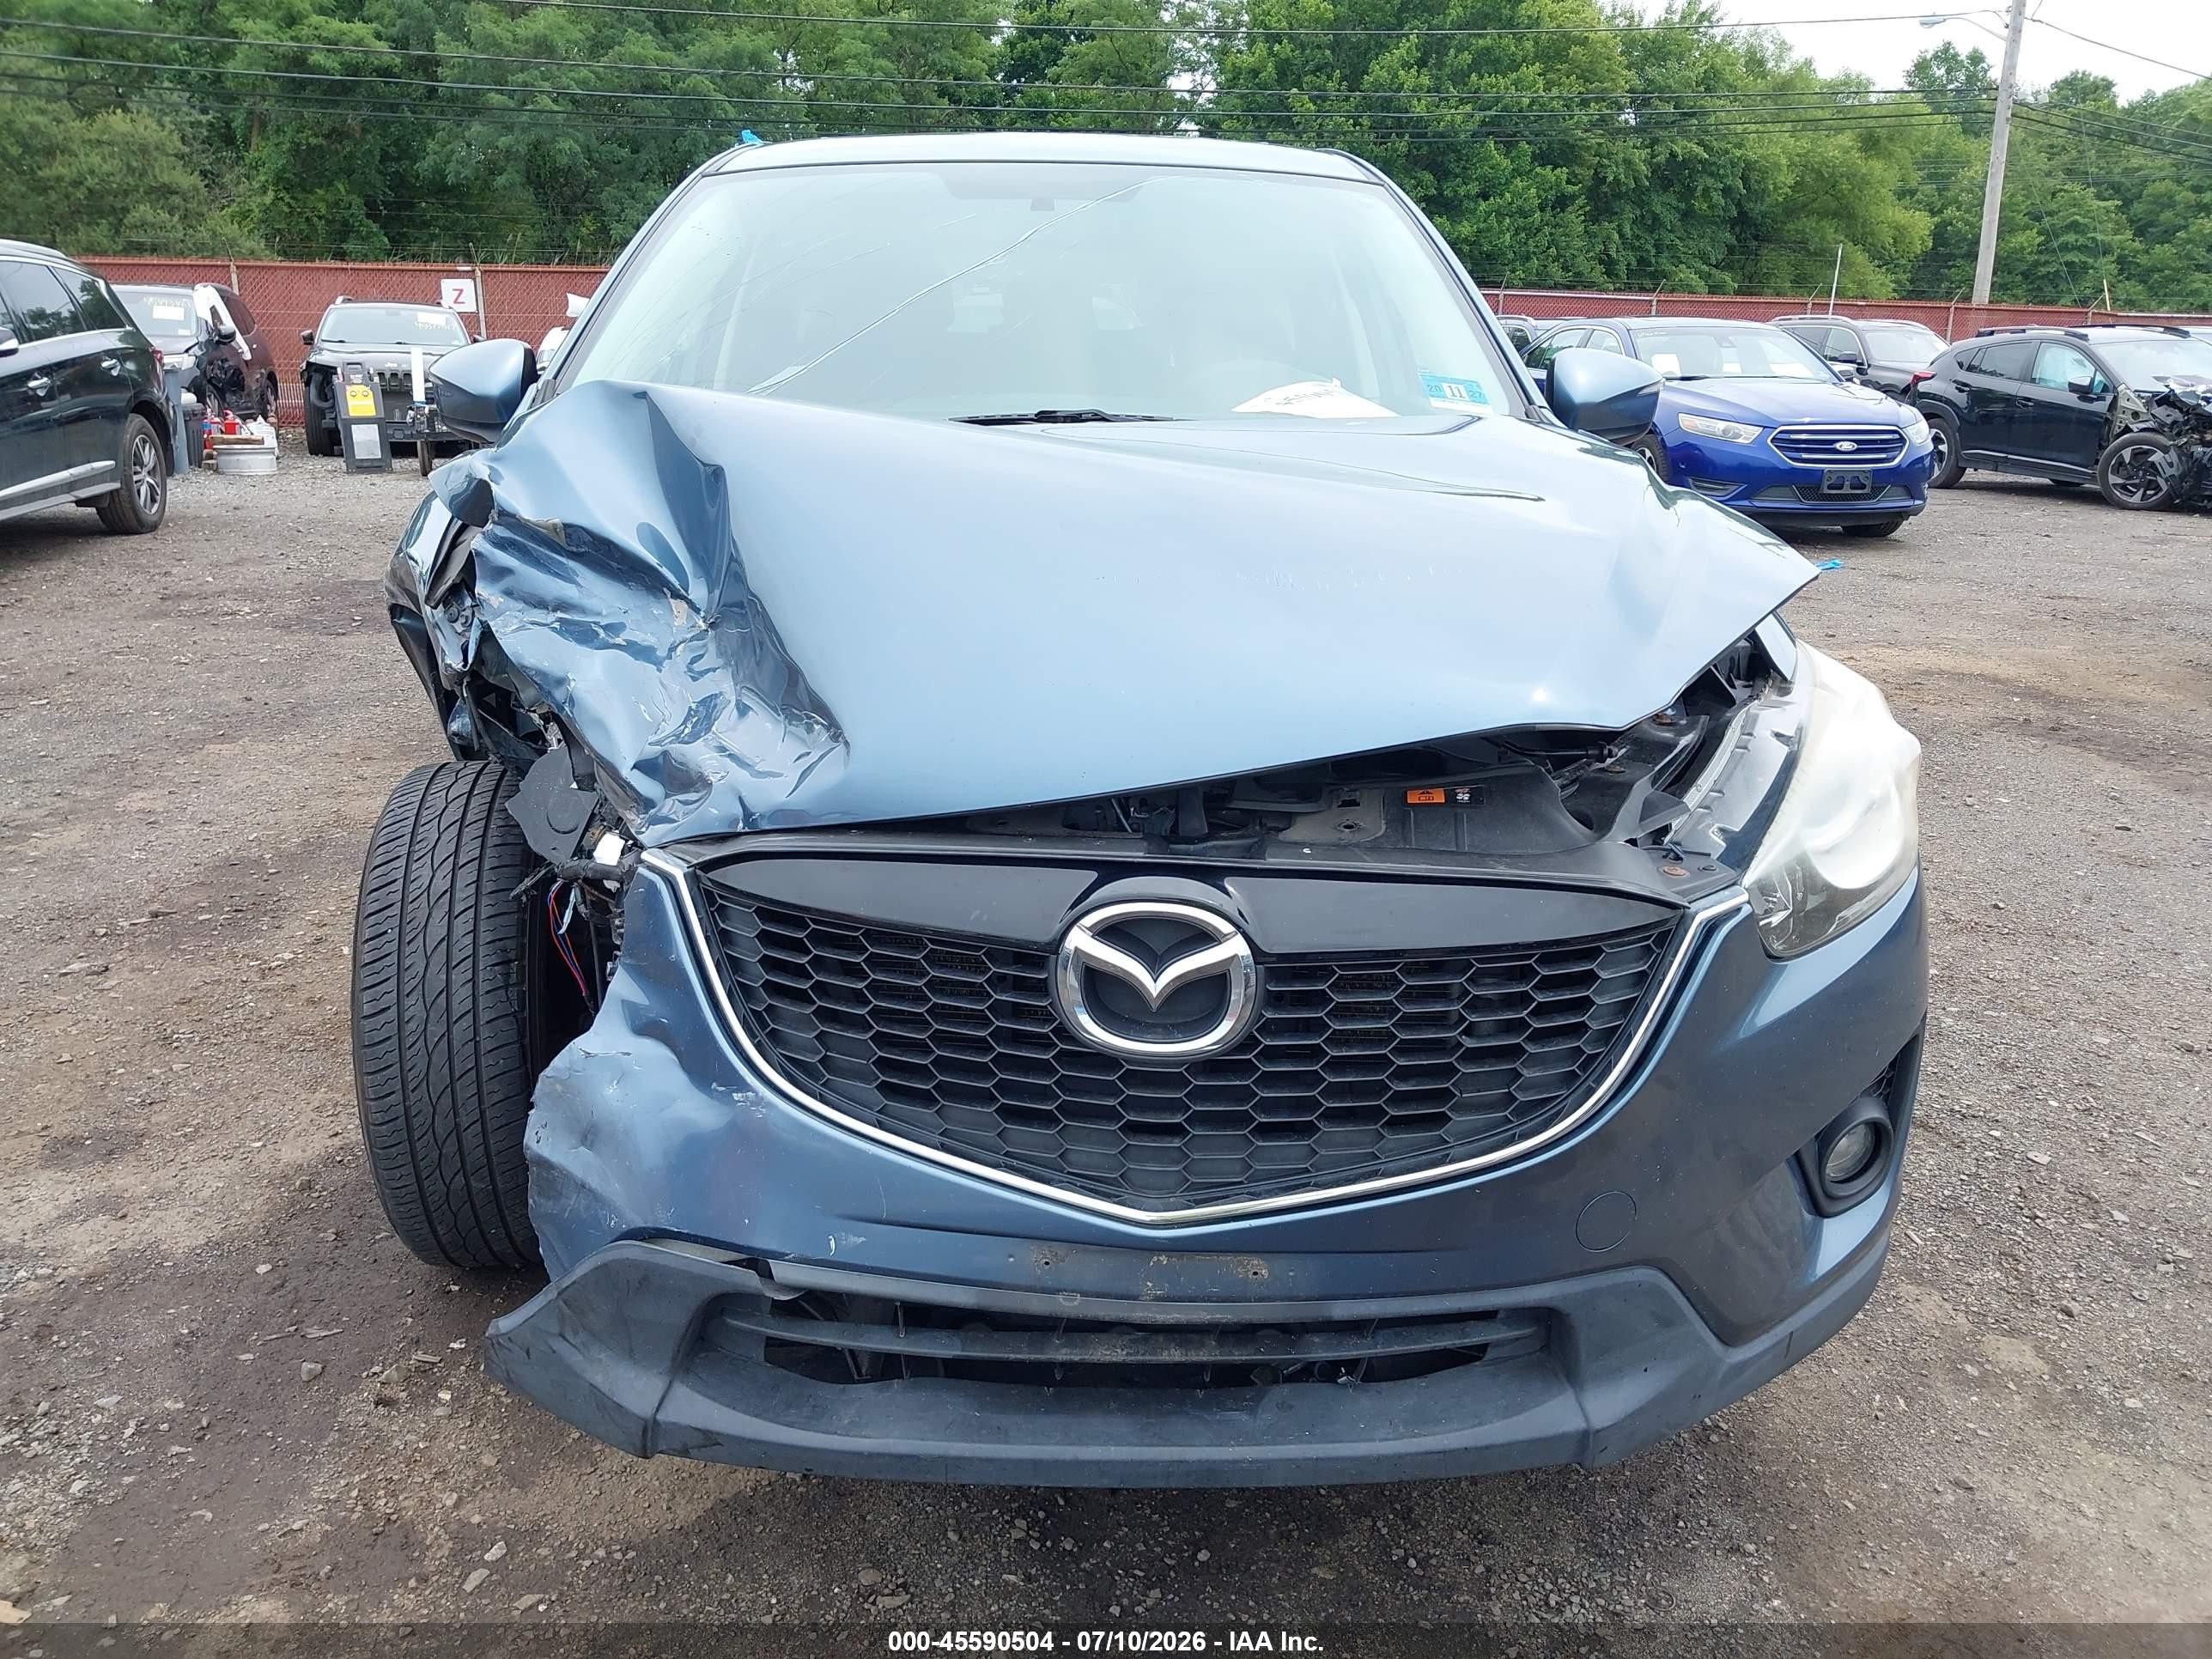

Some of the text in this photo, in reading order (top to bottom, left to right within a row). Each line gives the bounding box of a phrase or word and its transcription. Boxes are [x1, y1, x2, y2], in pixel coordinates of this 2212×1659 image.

[452, 289, 465, 305] Z
[1447, 386, 1466, 398] 11
[1468, 390, 1484, 398] 27
